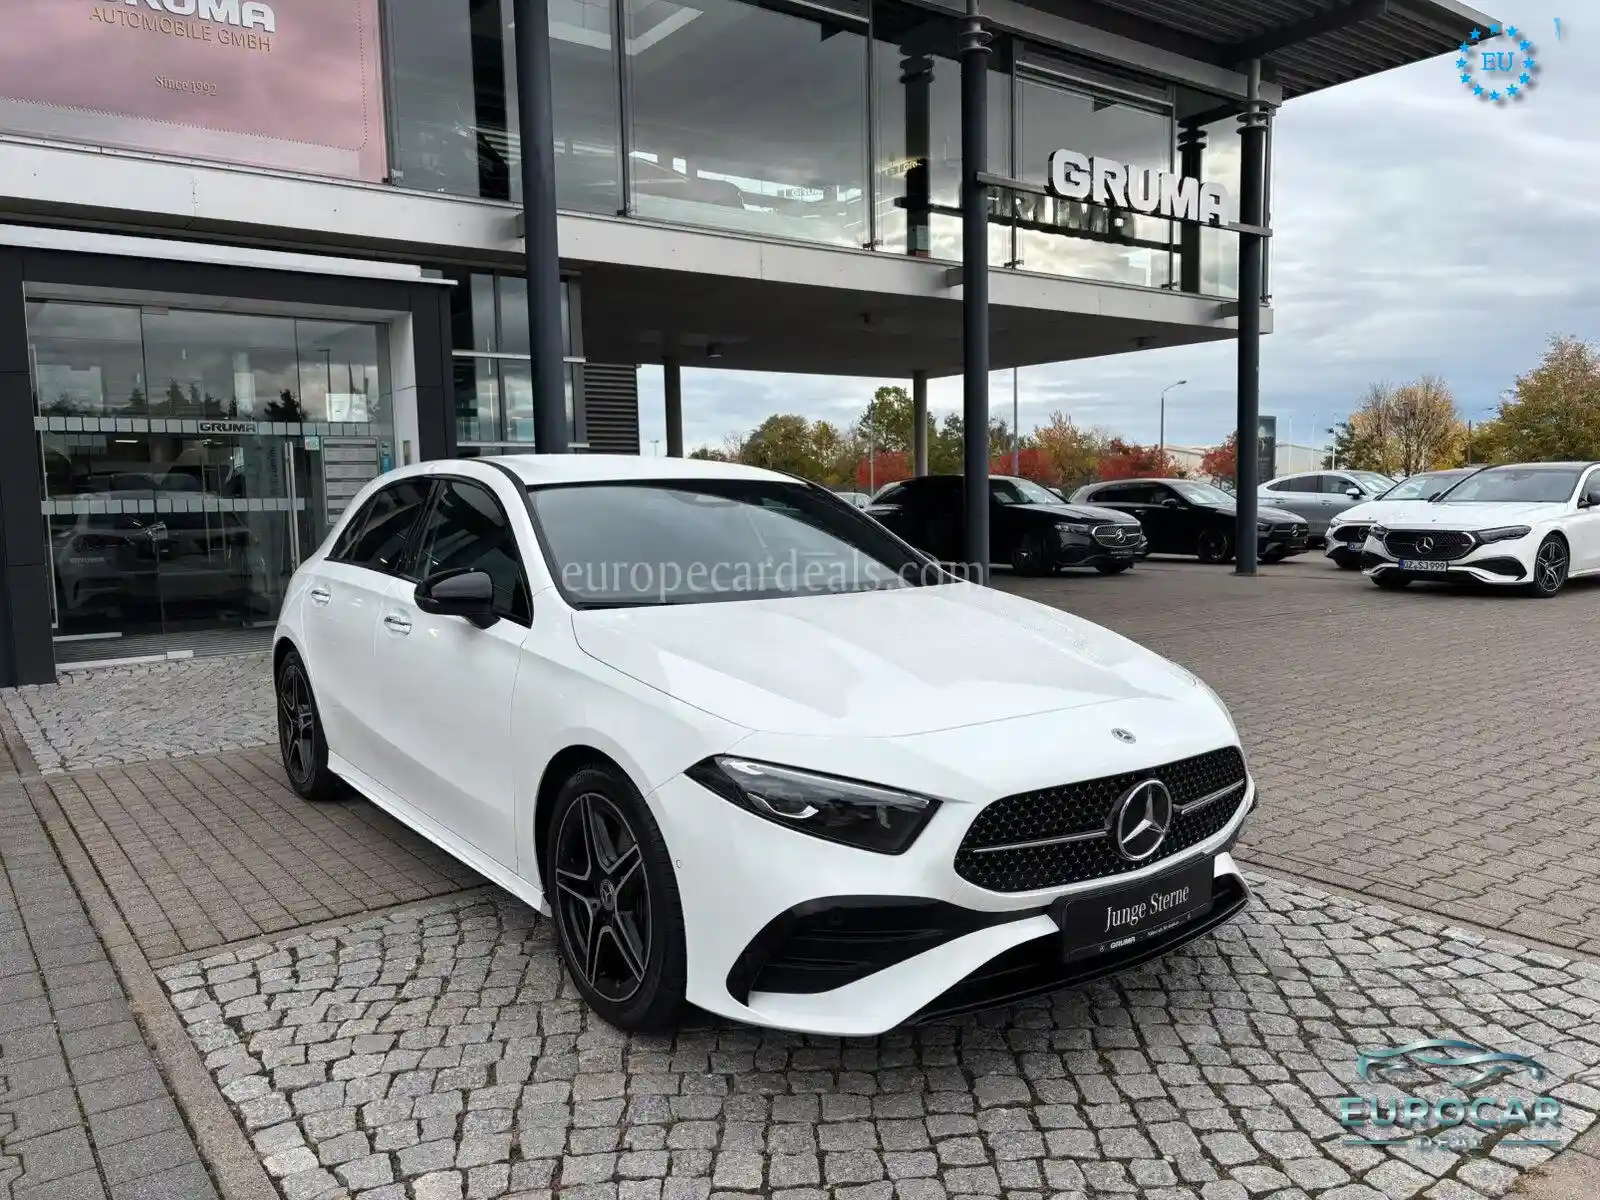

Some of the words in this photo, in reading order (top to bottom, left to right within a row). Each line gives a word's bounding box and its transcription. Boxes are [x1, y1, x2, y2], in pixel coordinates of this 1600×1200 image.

[90, 7, 212, 42] AUTOMOBILE
[217, 29, 272, 52] GMBH
[98, 0, 275, 32] UMA
[154, 75, 188, 91] Since
[1048, 149, 1230, 225] GRUMA
[199, 421, 257, 433] GRUMA
[1104, 902, 1147, 932] Junge
[1150, 885, 1190, 915] Sterne
